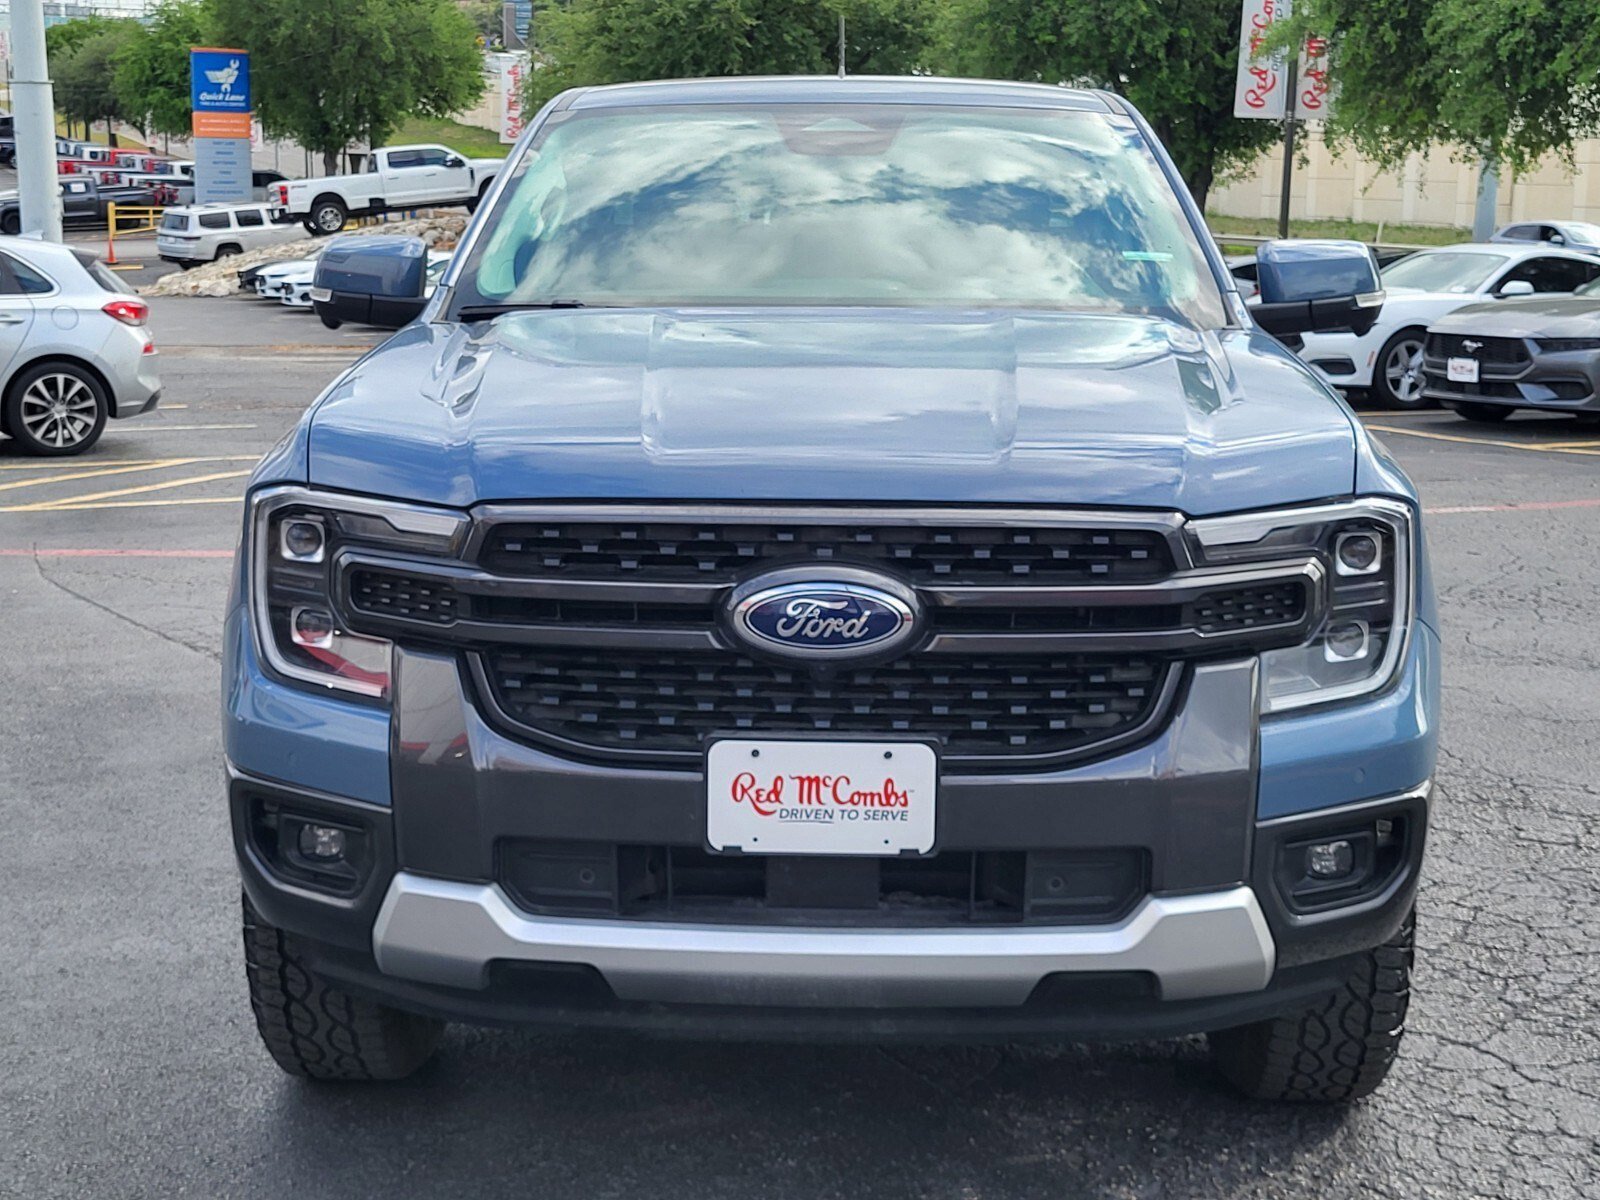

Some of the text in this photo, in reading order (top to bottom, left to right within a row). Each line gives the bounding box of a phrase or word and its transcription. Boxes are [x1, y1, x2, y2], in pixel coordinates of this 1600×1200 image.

[199, 92, 246, 101] Quick Lane
[1245, 66, 1276, 109] Red
[1302, 68, 1330, 110] Red
[506, 116, 526, 138] Red
[776, 598, 872, 638] Ford
[731, 772, 909, 816] Red McCombs
[779, 808, 909, 822] DRIVEN TO SERVE
